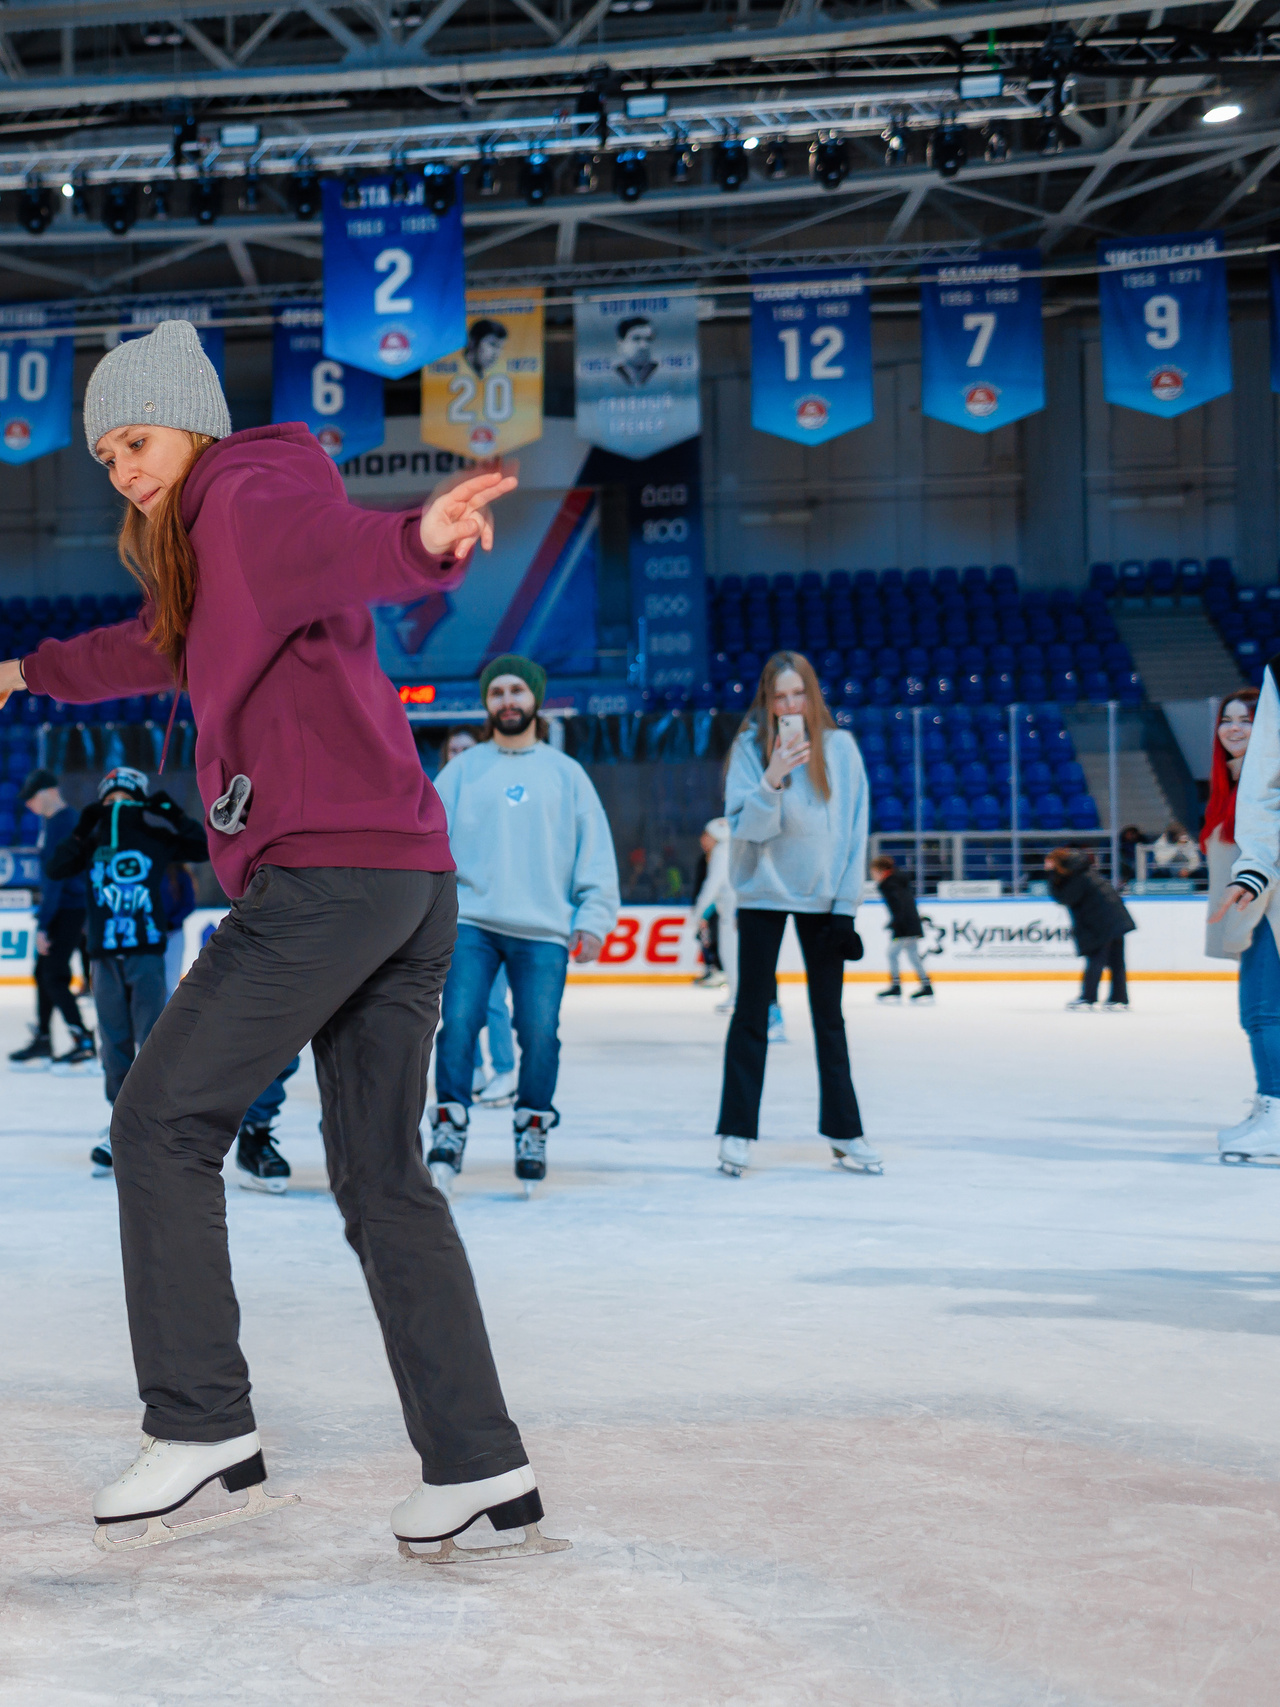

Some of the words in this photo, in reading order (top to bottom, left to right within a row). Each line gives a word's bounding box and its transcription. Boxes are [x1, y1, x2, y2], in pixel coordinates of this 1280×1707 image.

[374, 247, 414, 315] 2
[963, 313, 997, 367] 7
[1144, 295, 1181, 350] 9
[778, 326, 845, 381] 12
[311, 360, 344, 415] 6
[446, 374, 514, 424] 20
